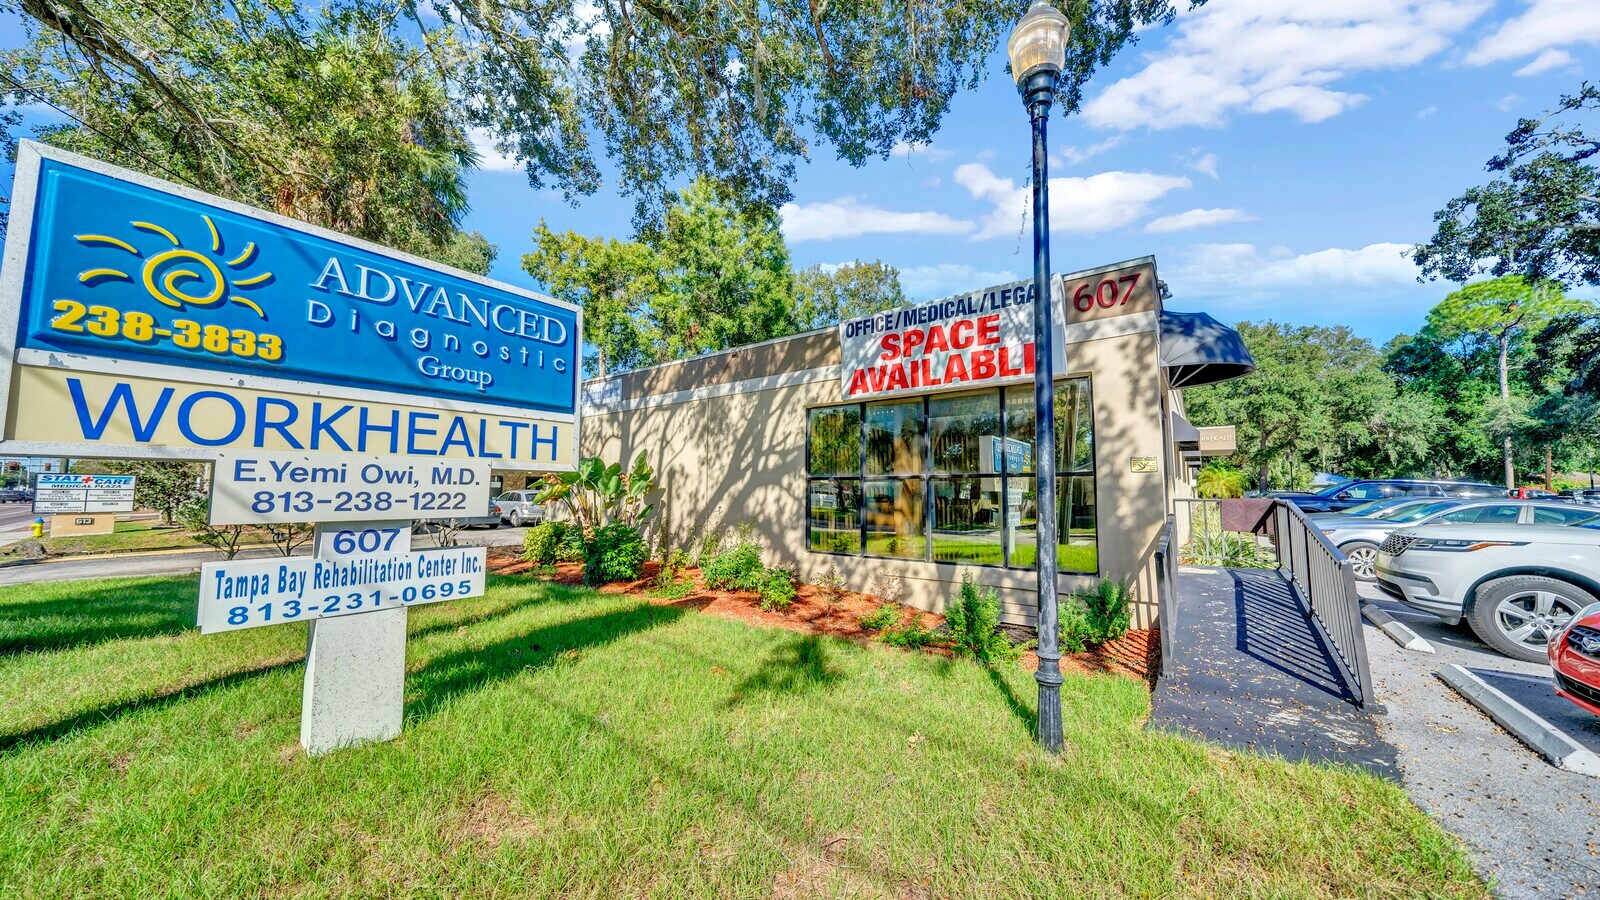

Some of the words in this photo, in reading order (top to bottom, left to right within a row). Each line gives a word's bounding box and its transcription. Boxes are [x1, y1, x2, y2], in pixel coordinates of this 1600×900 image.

[307, 256, 567, 345] ADVANCED
[1073, 272, 1141, 312] 607
[50, 299, 283, 361] 238-3833
[307, 299, 566, 372] Diagnostic
[880, 313, 1001, 361] SPACE
[416, 354, 493, 391] Group
[66, 377, 559, 462] WORKHEALTH
[360, 463, 419, 488] Owi,
[431, 466, 480, 486] M.D.
[251, 490, 467, 514] 813-238-1222
[333, 528, 401, 555] 607
[215, 569, 269, 604] Tampa
[277, 565, 307, 598] Bay
[313, 557, 412, 590] Rehabilitation
[417, 554, 458, 578] Center
[461, 552, 482, 574] Inc.
[227, 579, 472, 626] 813-231-0695
